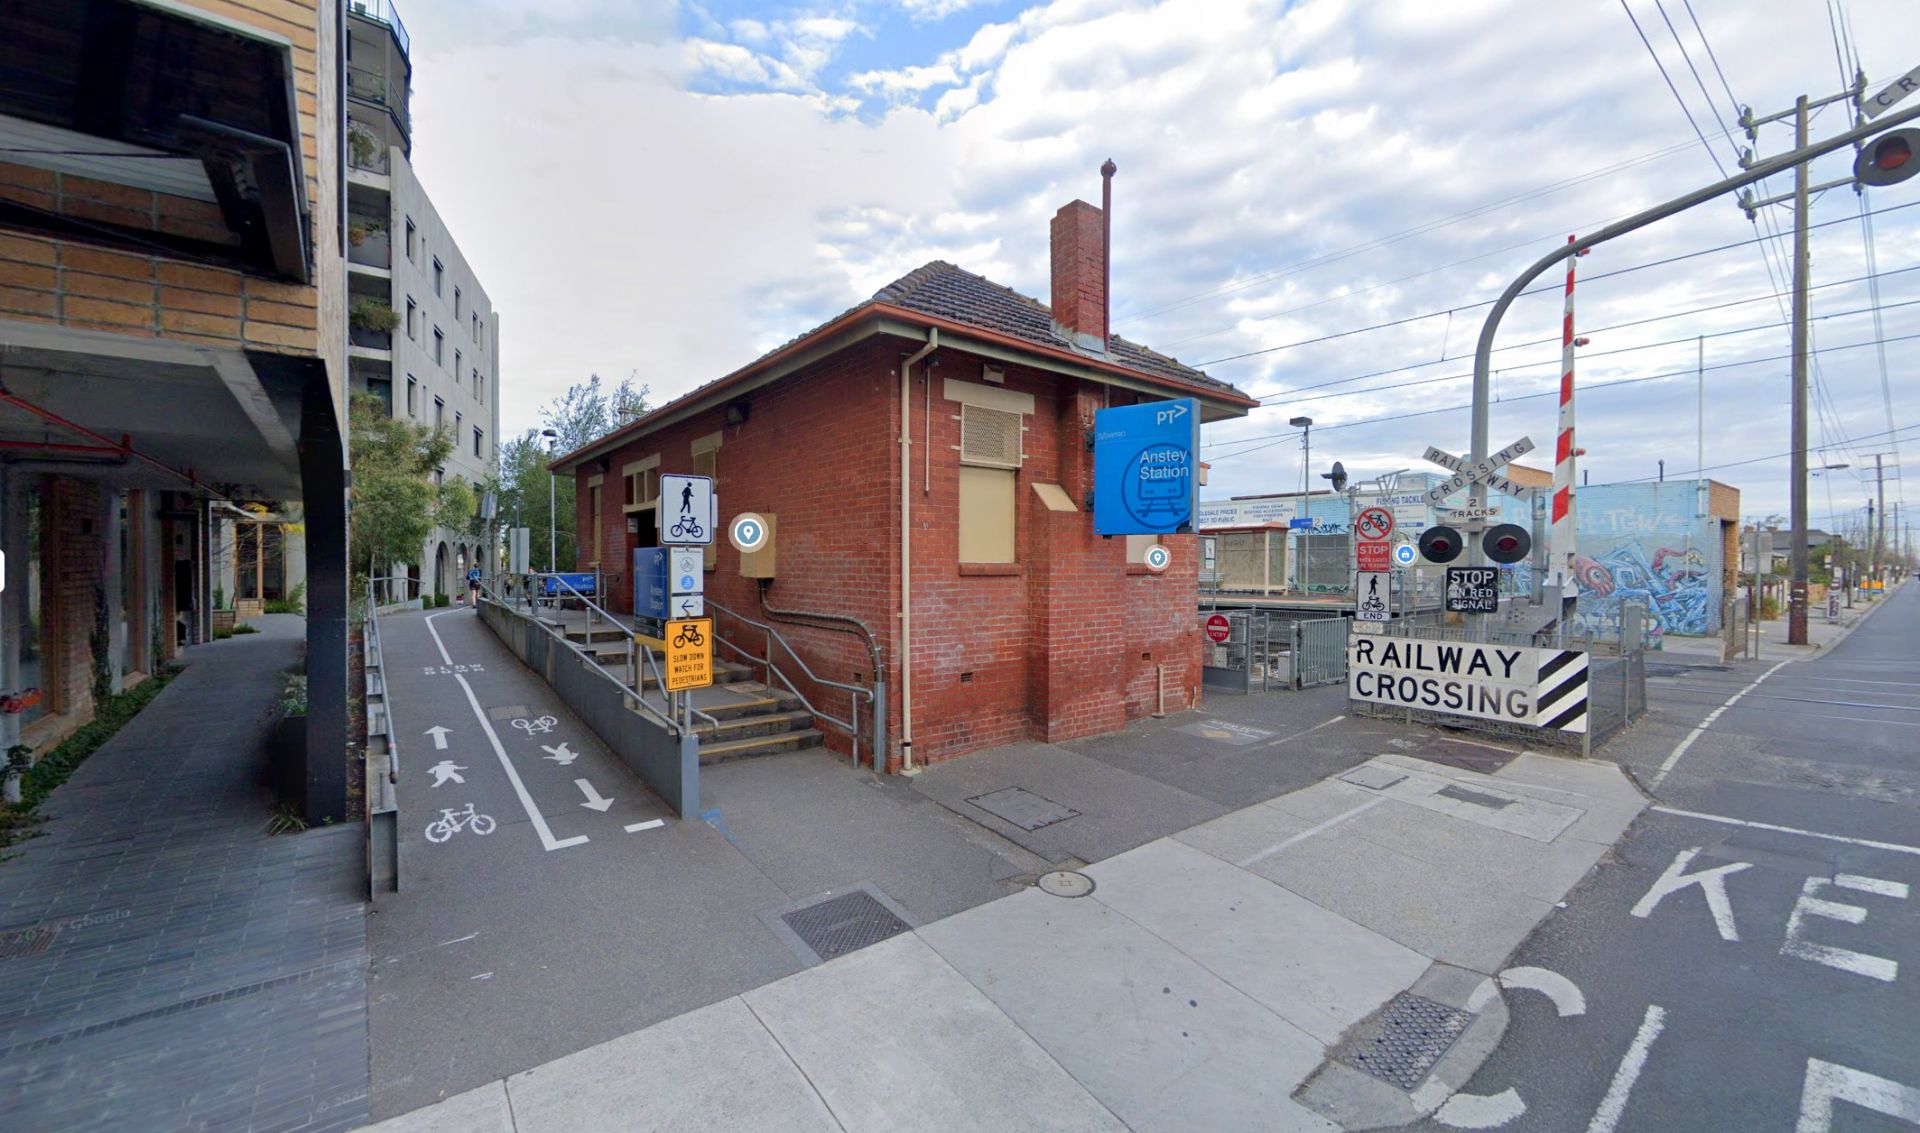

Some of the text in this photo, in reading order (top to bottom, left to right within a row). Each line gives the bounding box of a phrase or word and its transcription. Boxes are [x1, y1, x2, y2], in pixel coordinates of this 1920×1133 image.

[1140, 449, 1188, 464] Anstey
[1140, 465, 1188, 480] Station
[1429, 442, 1526, 502] CROSSING
[1469, 498, 1477, 507] 2
[1451, 508, 1496, 519] TRACKS
[1359, 545, 1388, 554] STOP
[1450, 571, 1494, 584] STOP
[1471, 588, 1494, 599] RED
[1451, 600, 1492, 610] SIGNAL
[673, 652, 704, 663] SLOW DOWN
[1356, 639, 1521, 679] RAILWAY
[674, 662, 704, 673] WATCH FOR
[672, 673, 707, 685] PEDESTRIANS
[1356, 671, 1530, 719] CROSSING
